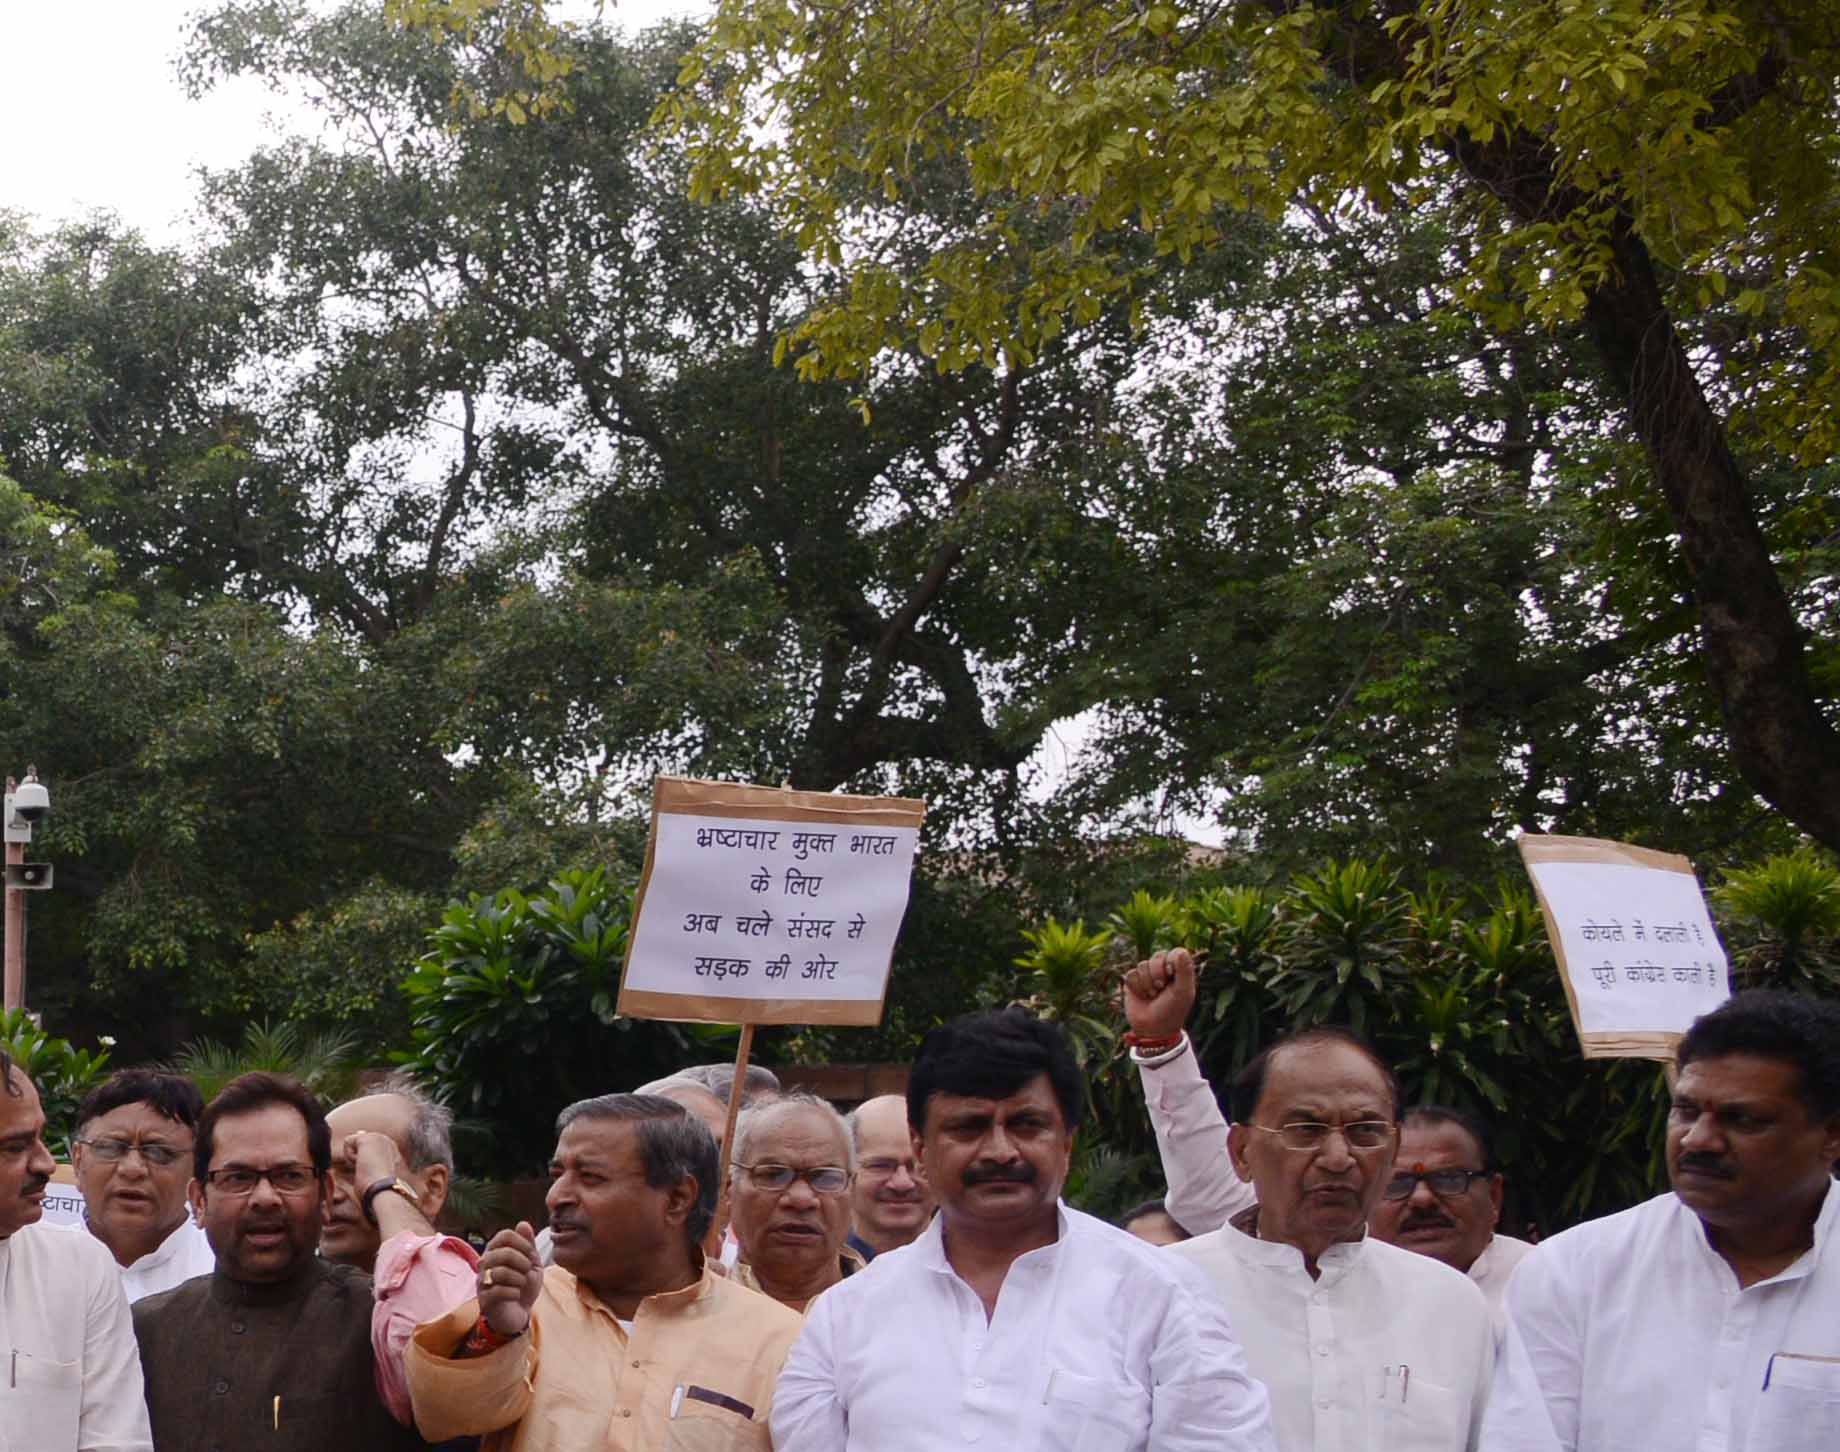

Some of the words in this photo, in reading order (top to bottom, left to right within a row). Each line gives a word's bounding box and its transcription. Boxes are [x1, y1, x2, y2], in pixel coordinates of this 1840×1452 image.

[696, 827, 781, 851] भ्रष्टाचार
[792, 831, 837, 860] मुक्त
[850, 834, 898, 856] भारत
[750, 866, 772, 895] के
[784, 867, 823, 898] लिए
[683, 912, 723, 935] अब
[735, 910, 773, 937] चले
[787, 912, 836, 939] संसद
[847, 913, 867, 939] से
[694, 956, 751, 982] सड़क
[764, 953, 792, 980] की
[800, 953, 840, 981] ओर
